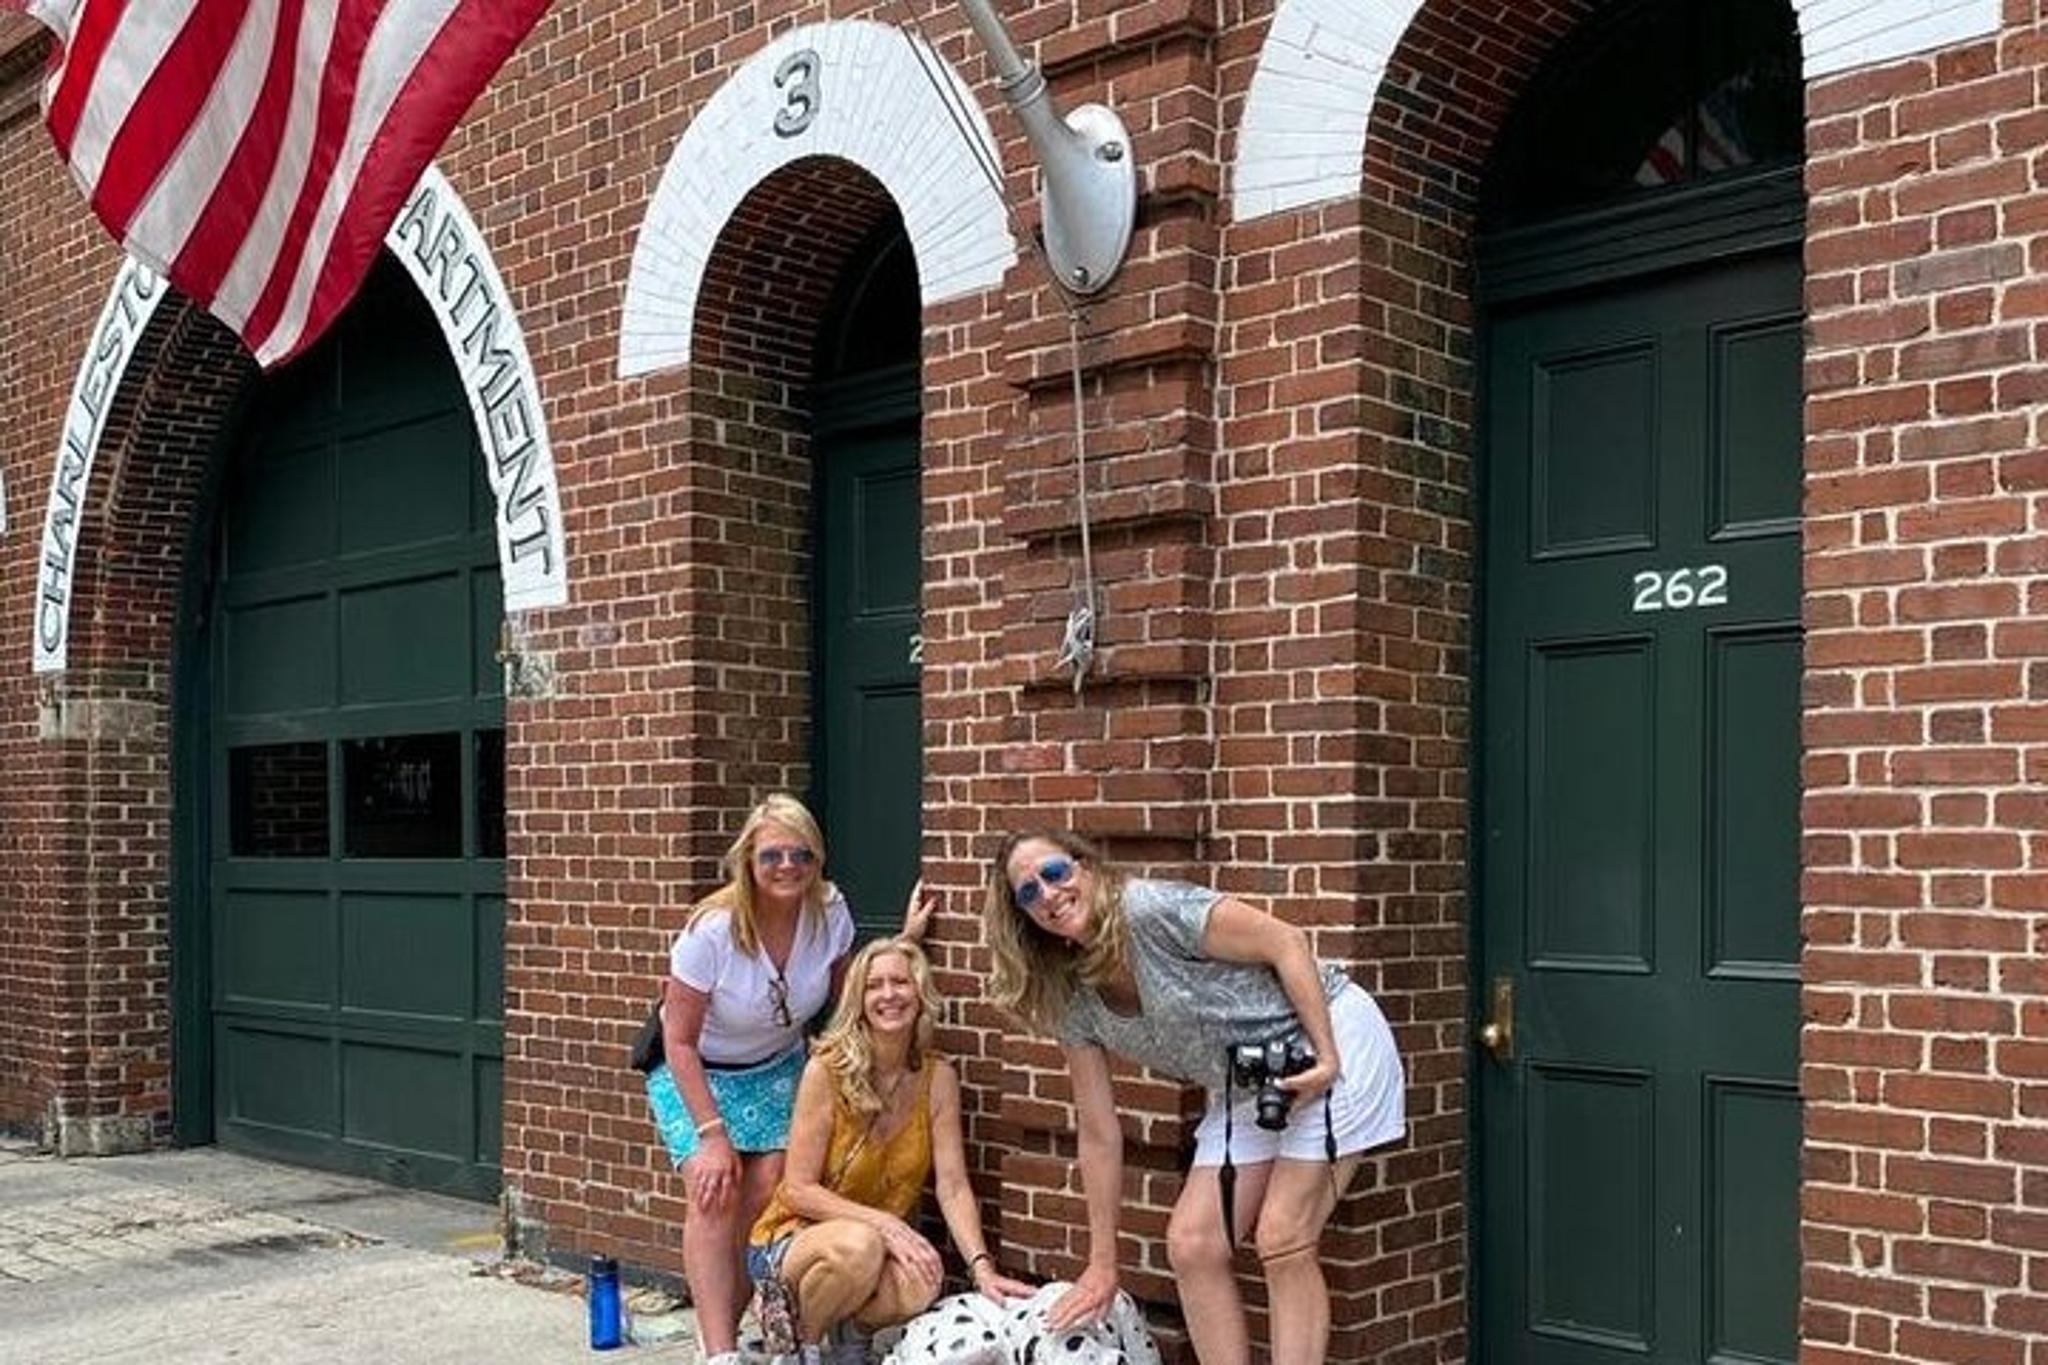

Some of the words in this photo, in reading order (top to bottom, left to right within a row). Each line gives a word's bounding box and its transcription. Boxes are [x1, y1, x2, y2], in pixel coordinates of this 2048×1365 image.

[773, 48, 821, 138] 3
[396, 187, 552, 575] ARTMENT
[1633, 564, 1728, 612] 262
